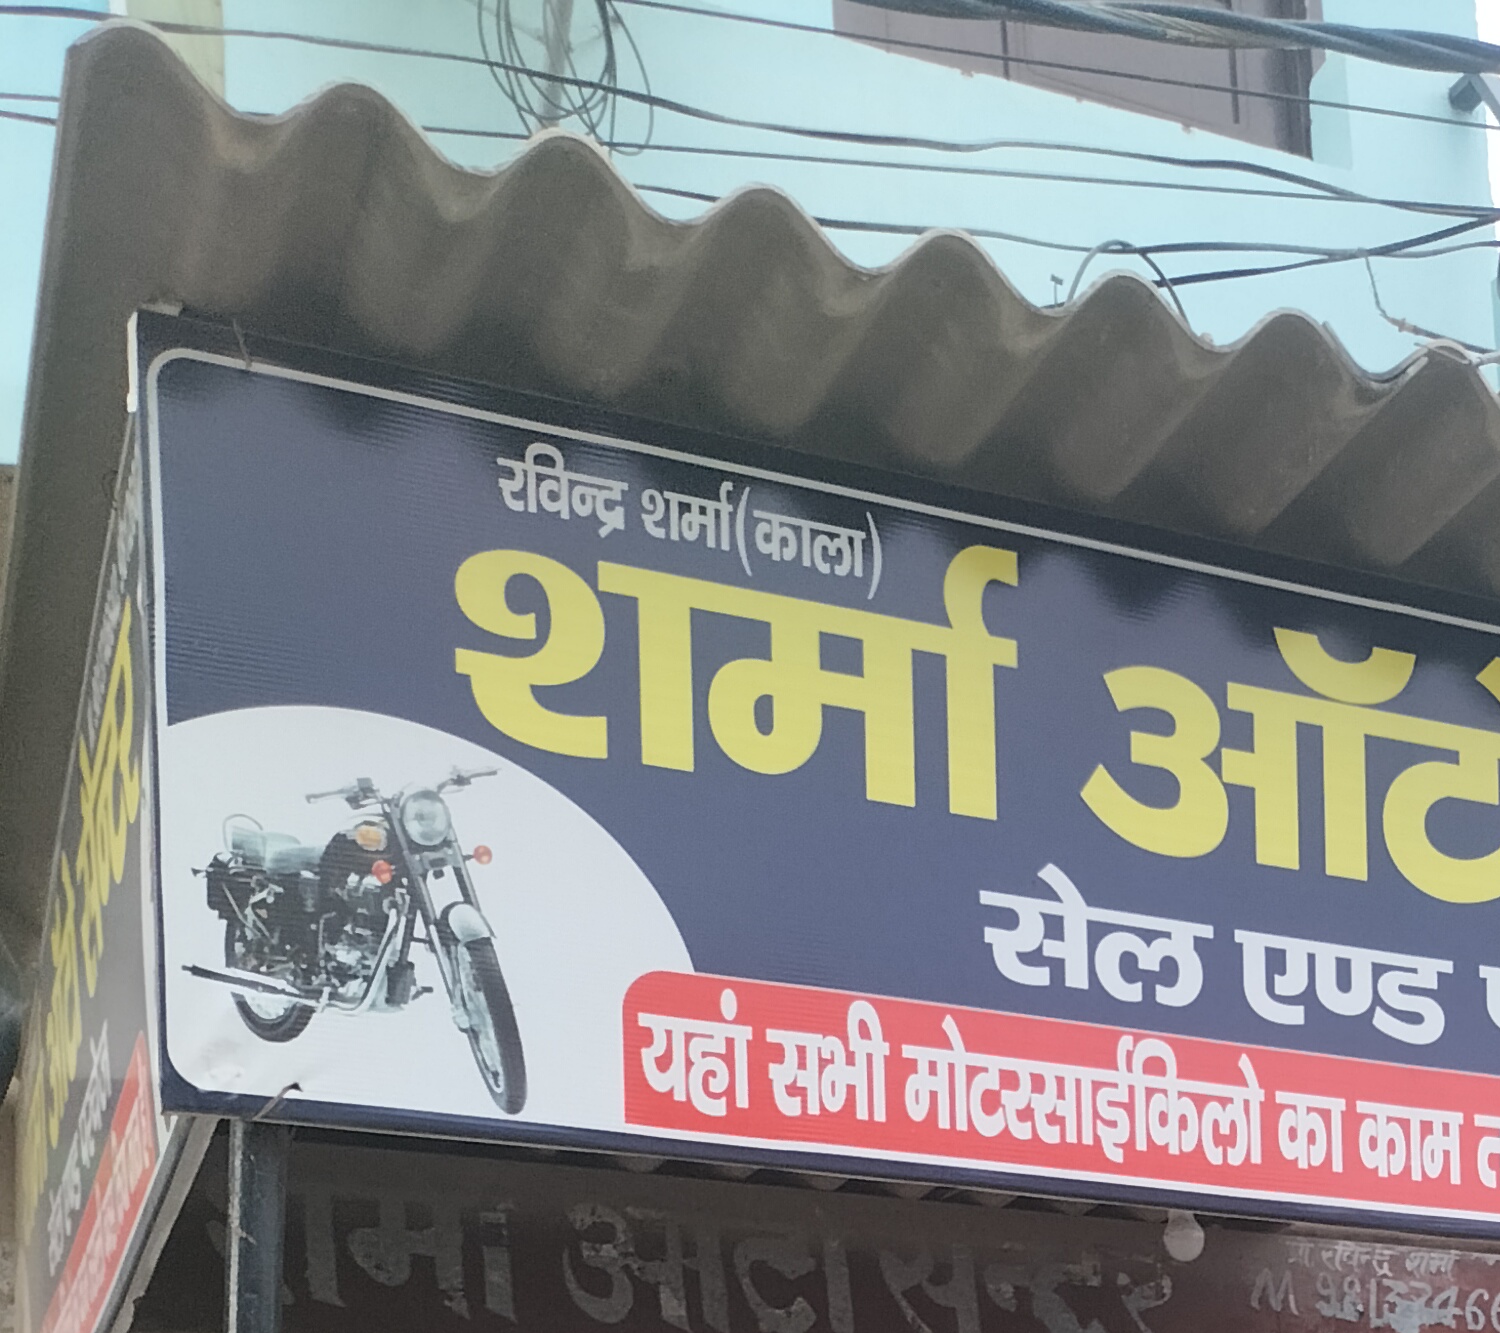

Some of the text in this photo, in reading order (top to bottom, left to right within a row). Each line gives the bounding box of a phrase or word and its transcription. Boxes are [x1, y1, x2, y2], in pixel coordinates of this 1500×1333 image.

[496, 442, 629, 538] रविन्द्र
[454, 544, 1018, 821] शर्मा
[979, 863, 1214, 1007] सेल
[1234, 929, 1454, 1046] एण्ड
[637, 988, 753, 1117] यहां
[765, 1000, 890, 1123] सभी
[1275, 1091, 1346, 1173] का
[1355, 1100, 1464, 1186] काम
